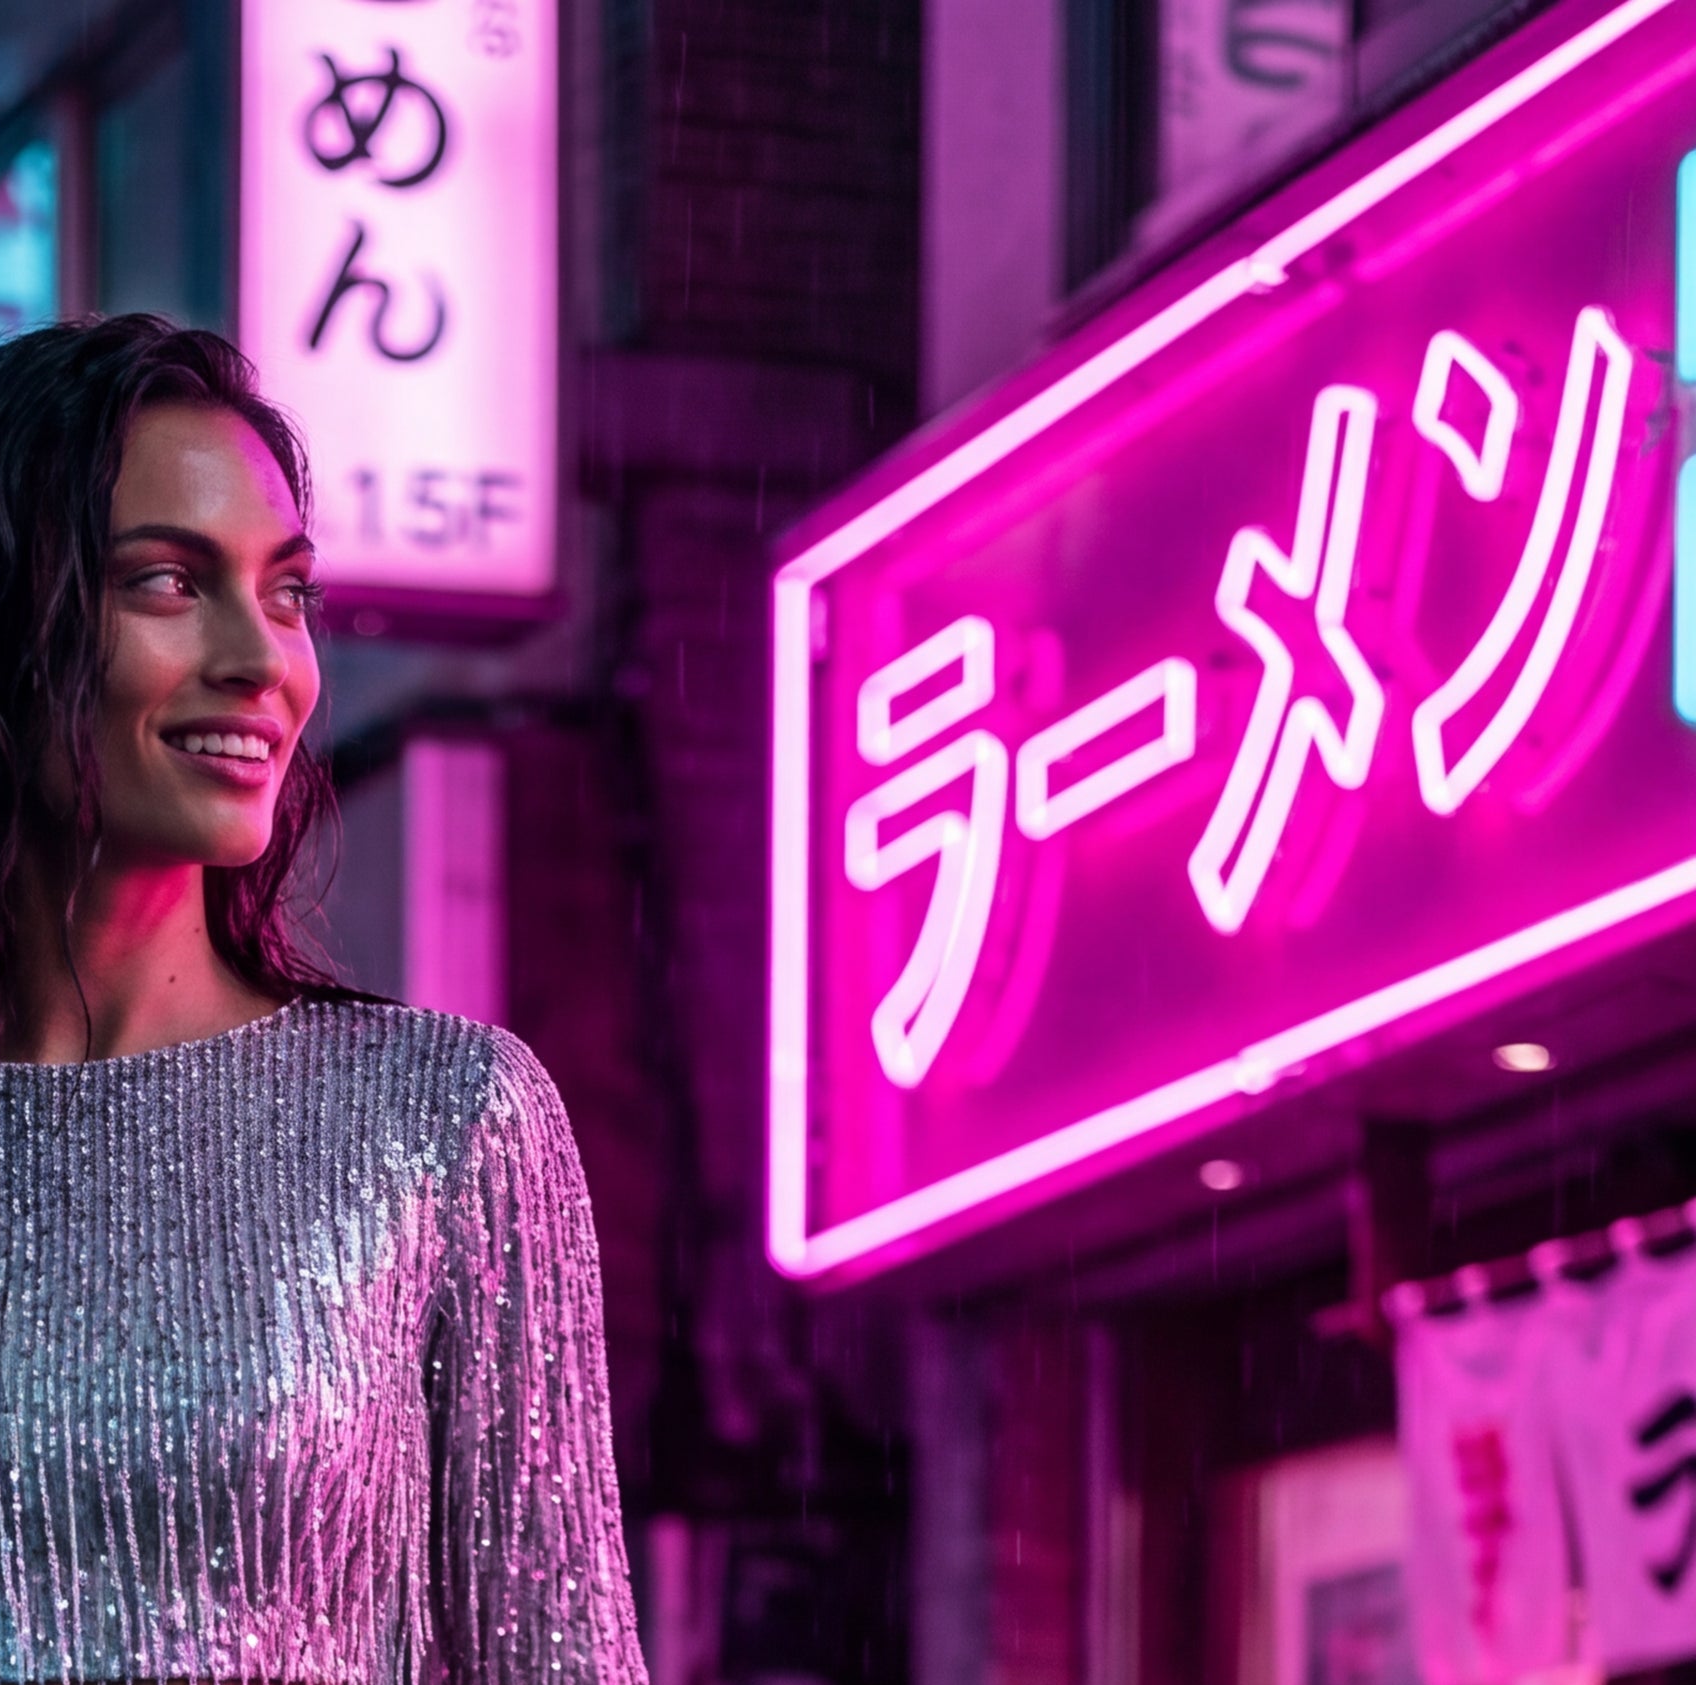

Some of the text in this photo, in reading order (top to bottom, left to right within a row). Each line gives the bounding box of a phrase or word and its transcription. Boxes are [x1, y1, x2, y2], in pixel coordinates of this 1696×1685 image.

[305, 0, 446, 363] めん
[844, 304, 1635, 1090] ラーメン
